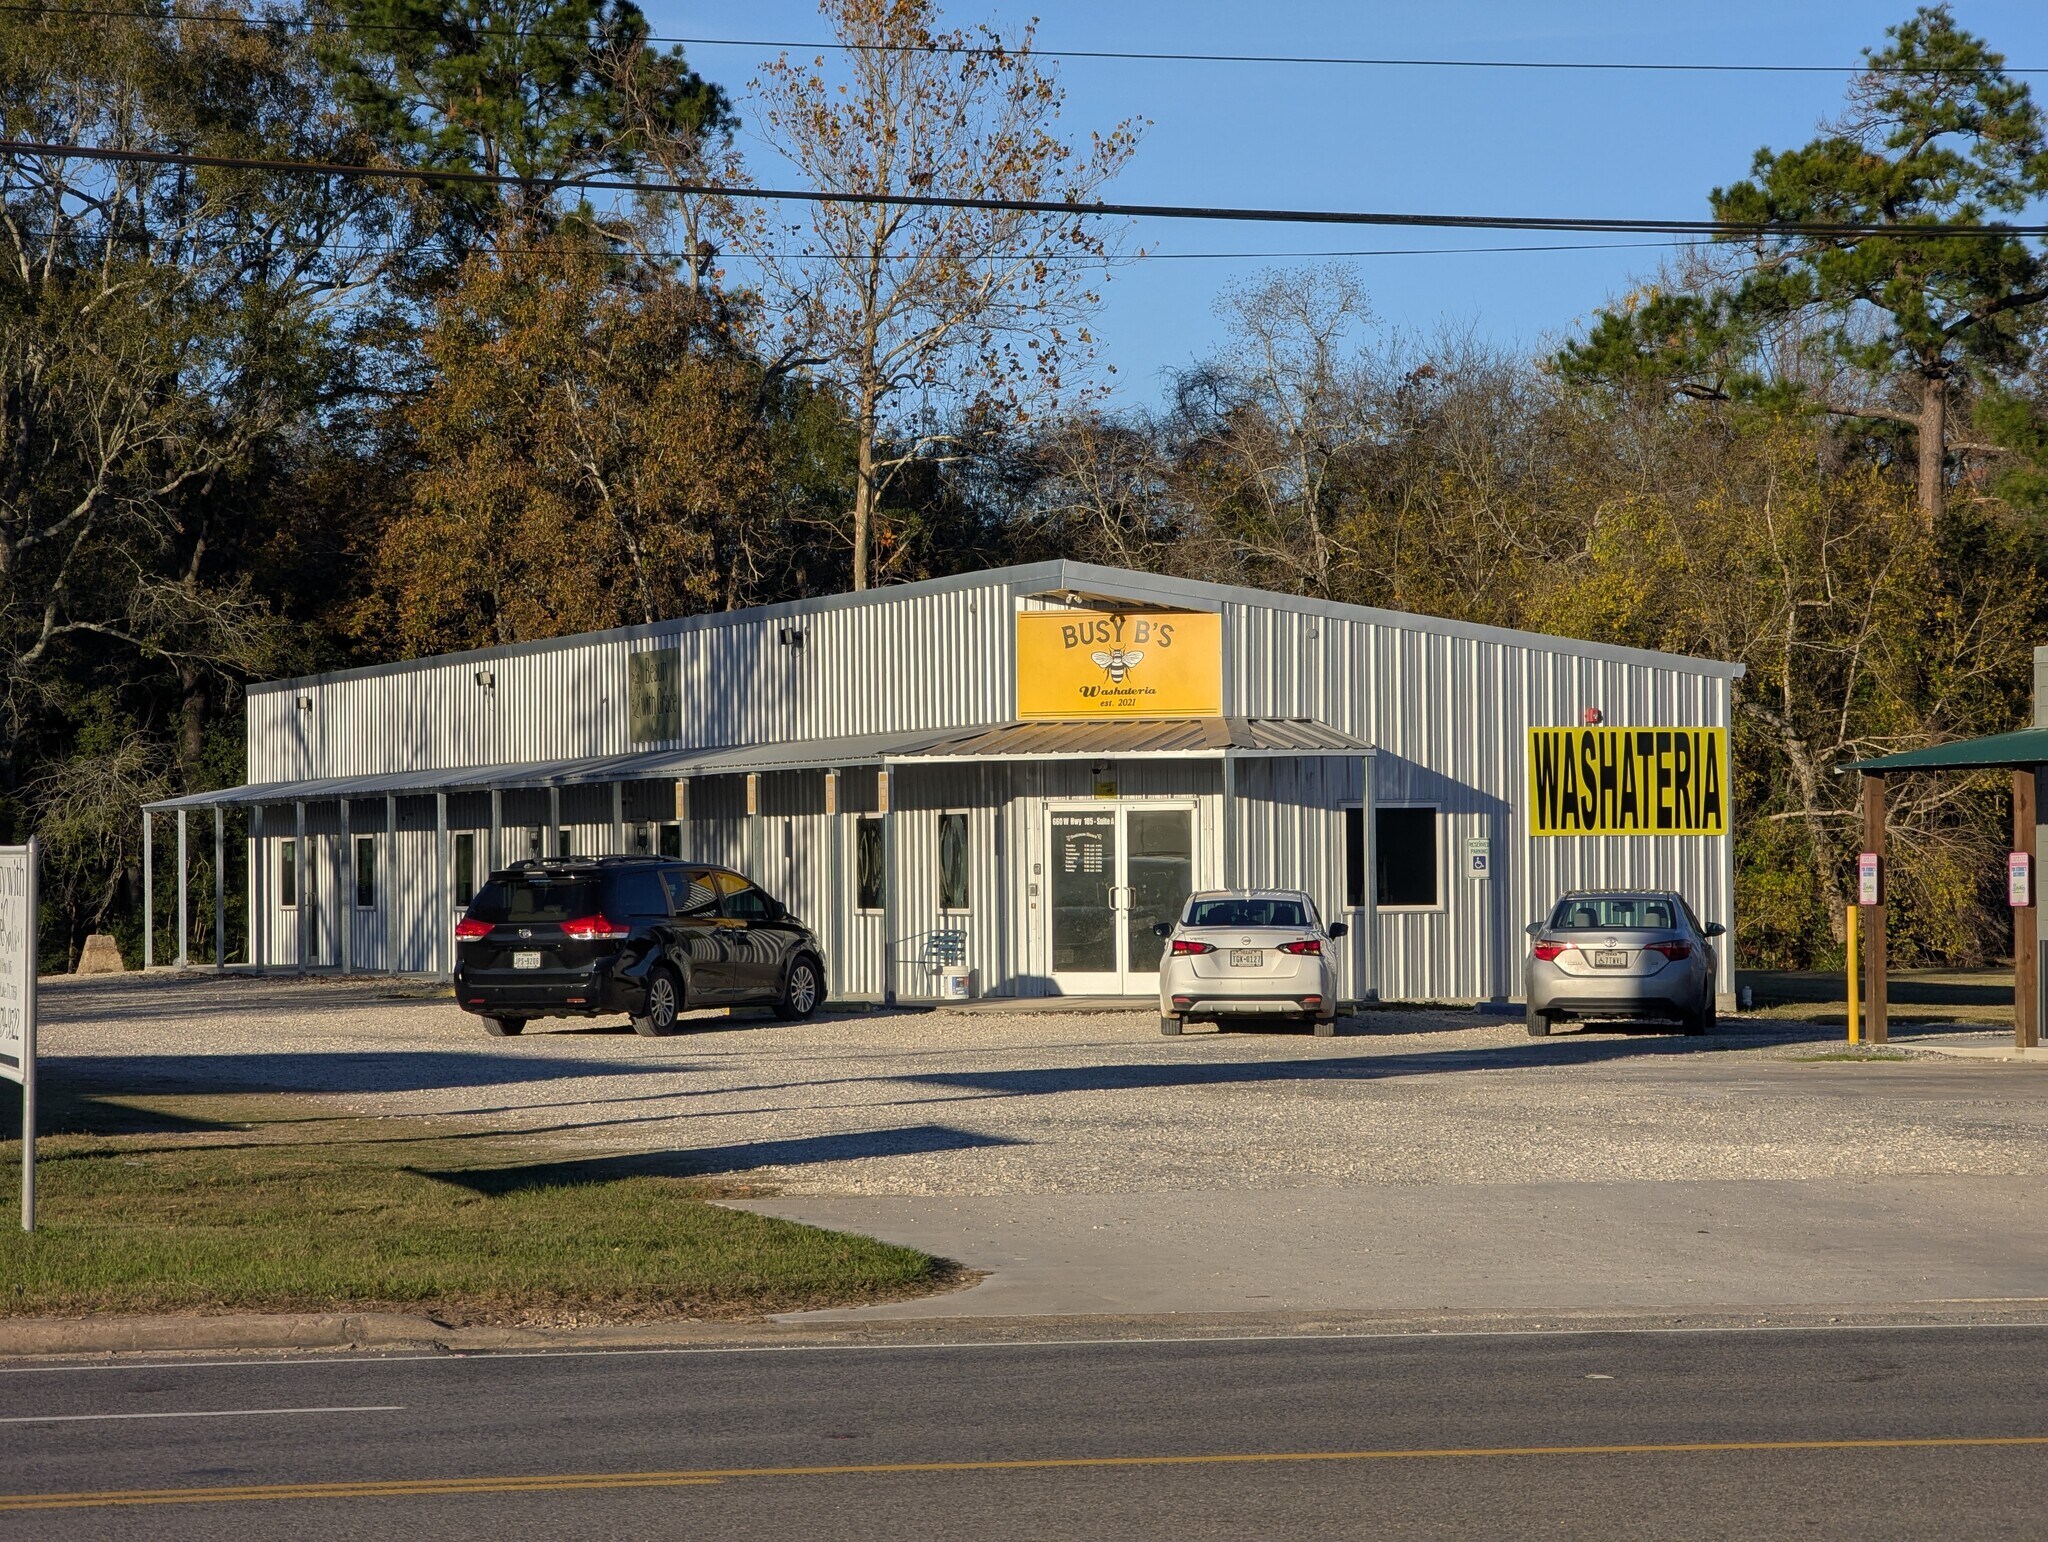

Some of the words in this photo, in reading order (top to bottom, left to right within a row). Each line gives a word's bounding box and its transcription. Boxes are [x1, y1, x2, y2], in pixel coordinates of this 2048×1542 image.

[1061, 619, 1126, 649] BUSY
[1134, 620, 1175, 648] B'S
[1079, 686, 1157, 698] Washateria
[1118, 699, 1136, 707] 2021
[1533, 730, 1722, 831] WASHATERIA
[7, 858, 25, 897] with
